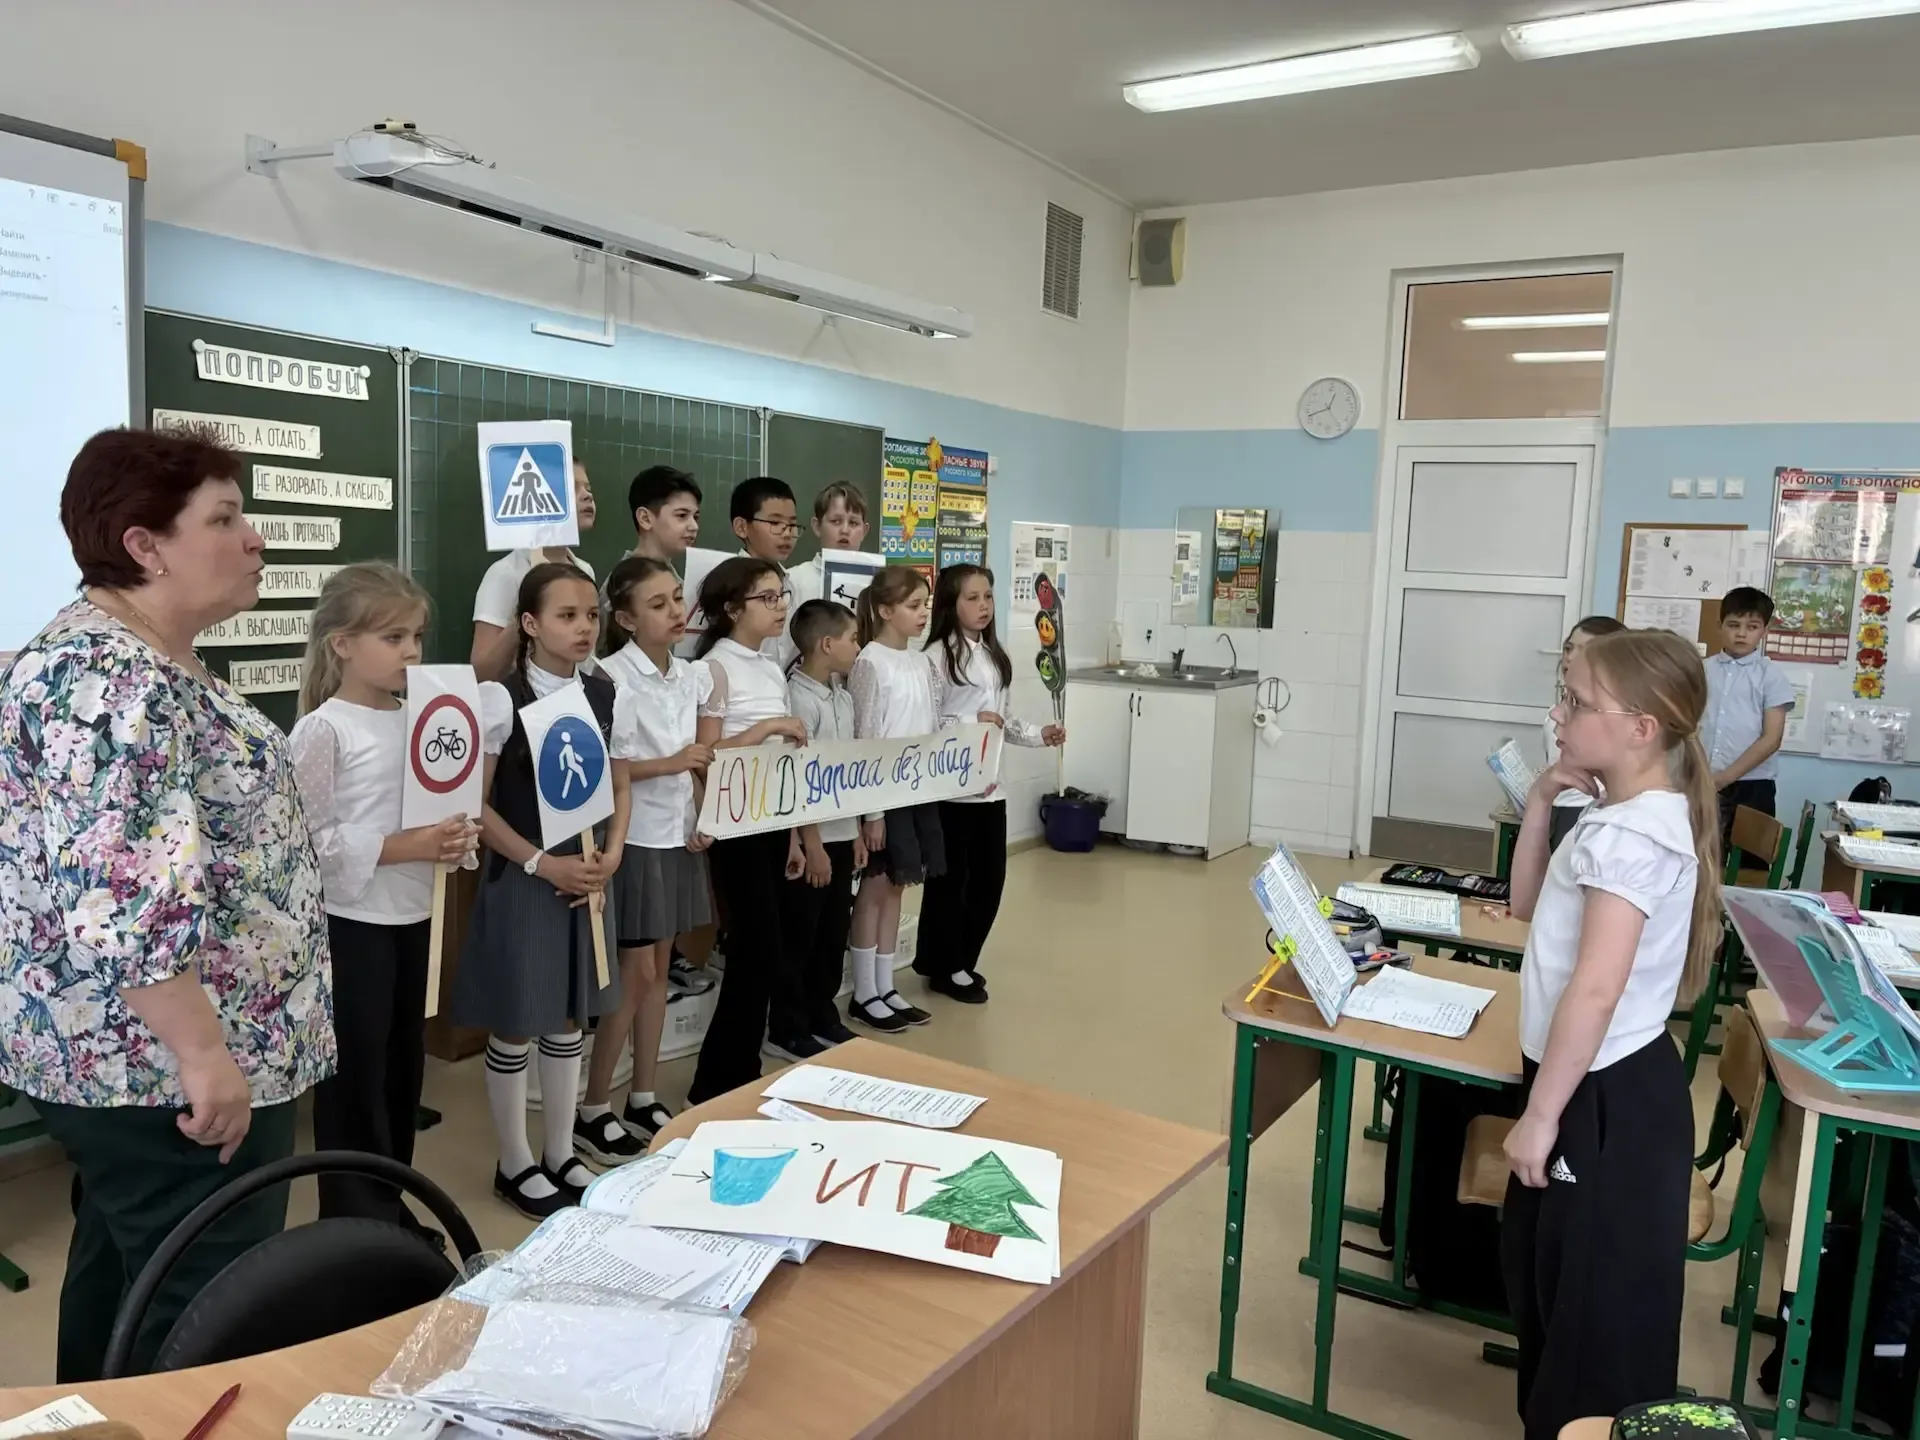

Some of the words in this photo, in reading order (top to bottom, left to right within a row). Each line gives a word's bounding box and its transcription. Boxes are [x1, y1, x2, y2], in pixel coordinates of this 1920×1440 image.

[203, 348, 361, 396] ПОПРОБУЙ
[254, 425, 264, 446] А
[943, 455, 968, 467] ЛАСНЫЕ
[256, 471, 271, 492] НЕ
[275, 474, 333, 498] РАЗОРВАТЬ,
[335, 480, 341, 497] А
[1781, 475, 1834, 486] УГОЛОК
[1840, 477, 1920, 489] БЕЗОПАСНО
[265, 571, 316, 591] СПРЯТАТЬ,
[234, 619, 241, 637] А
[247, 616, 309, 637] ВЫСЛУШАТЬ
[232, 667, 247, 687] НЕ
[804, 753, 884, 809] Дорога
[891, 743, 923, 790] без
